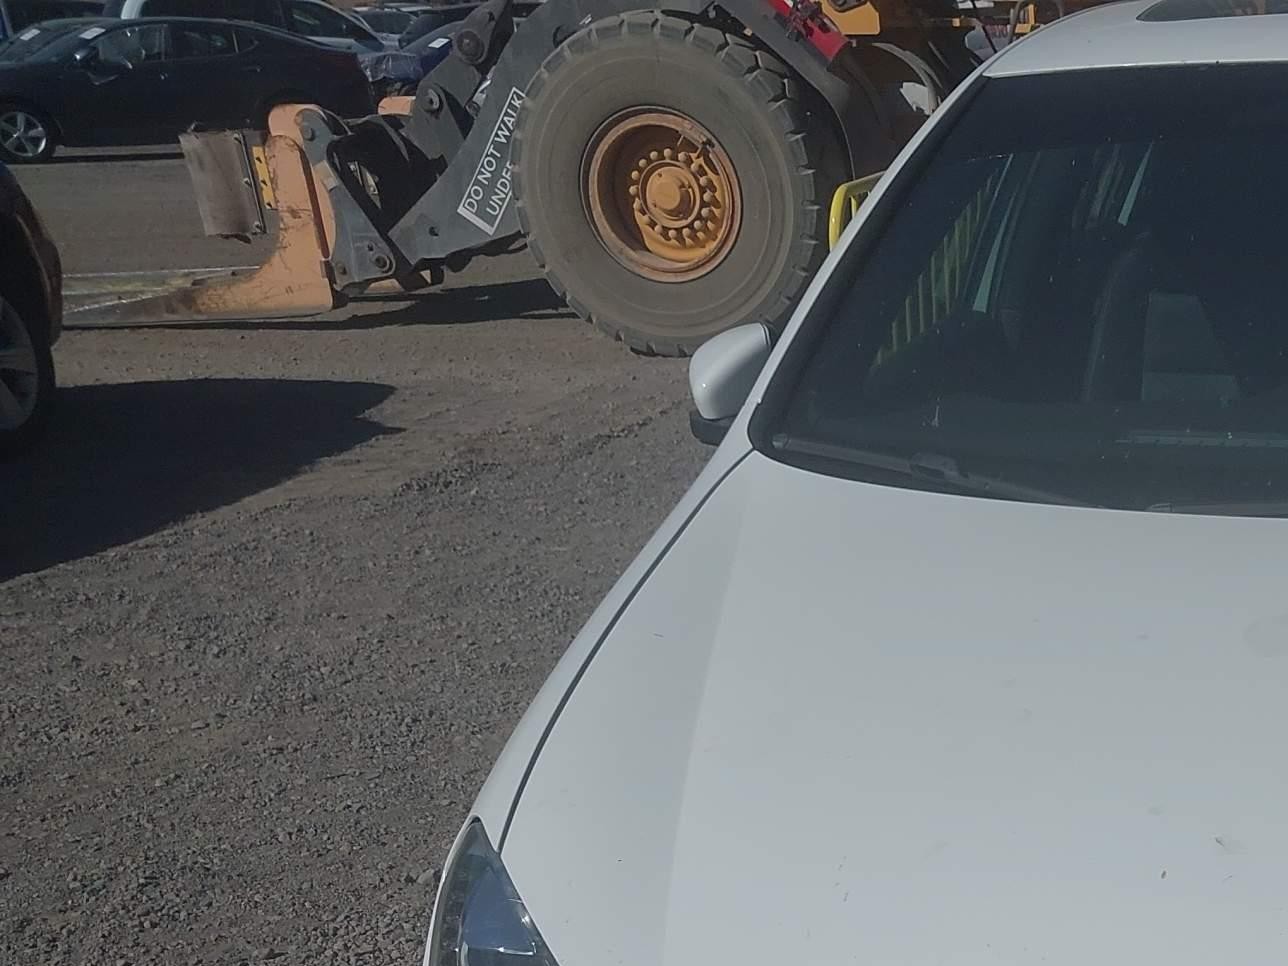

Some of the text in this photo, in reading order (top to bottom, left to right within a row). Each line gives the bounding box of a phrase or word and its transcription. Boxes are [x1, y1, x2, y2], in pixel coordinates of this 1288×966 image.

[464, 95, 523, 213] DO NOT WALK
